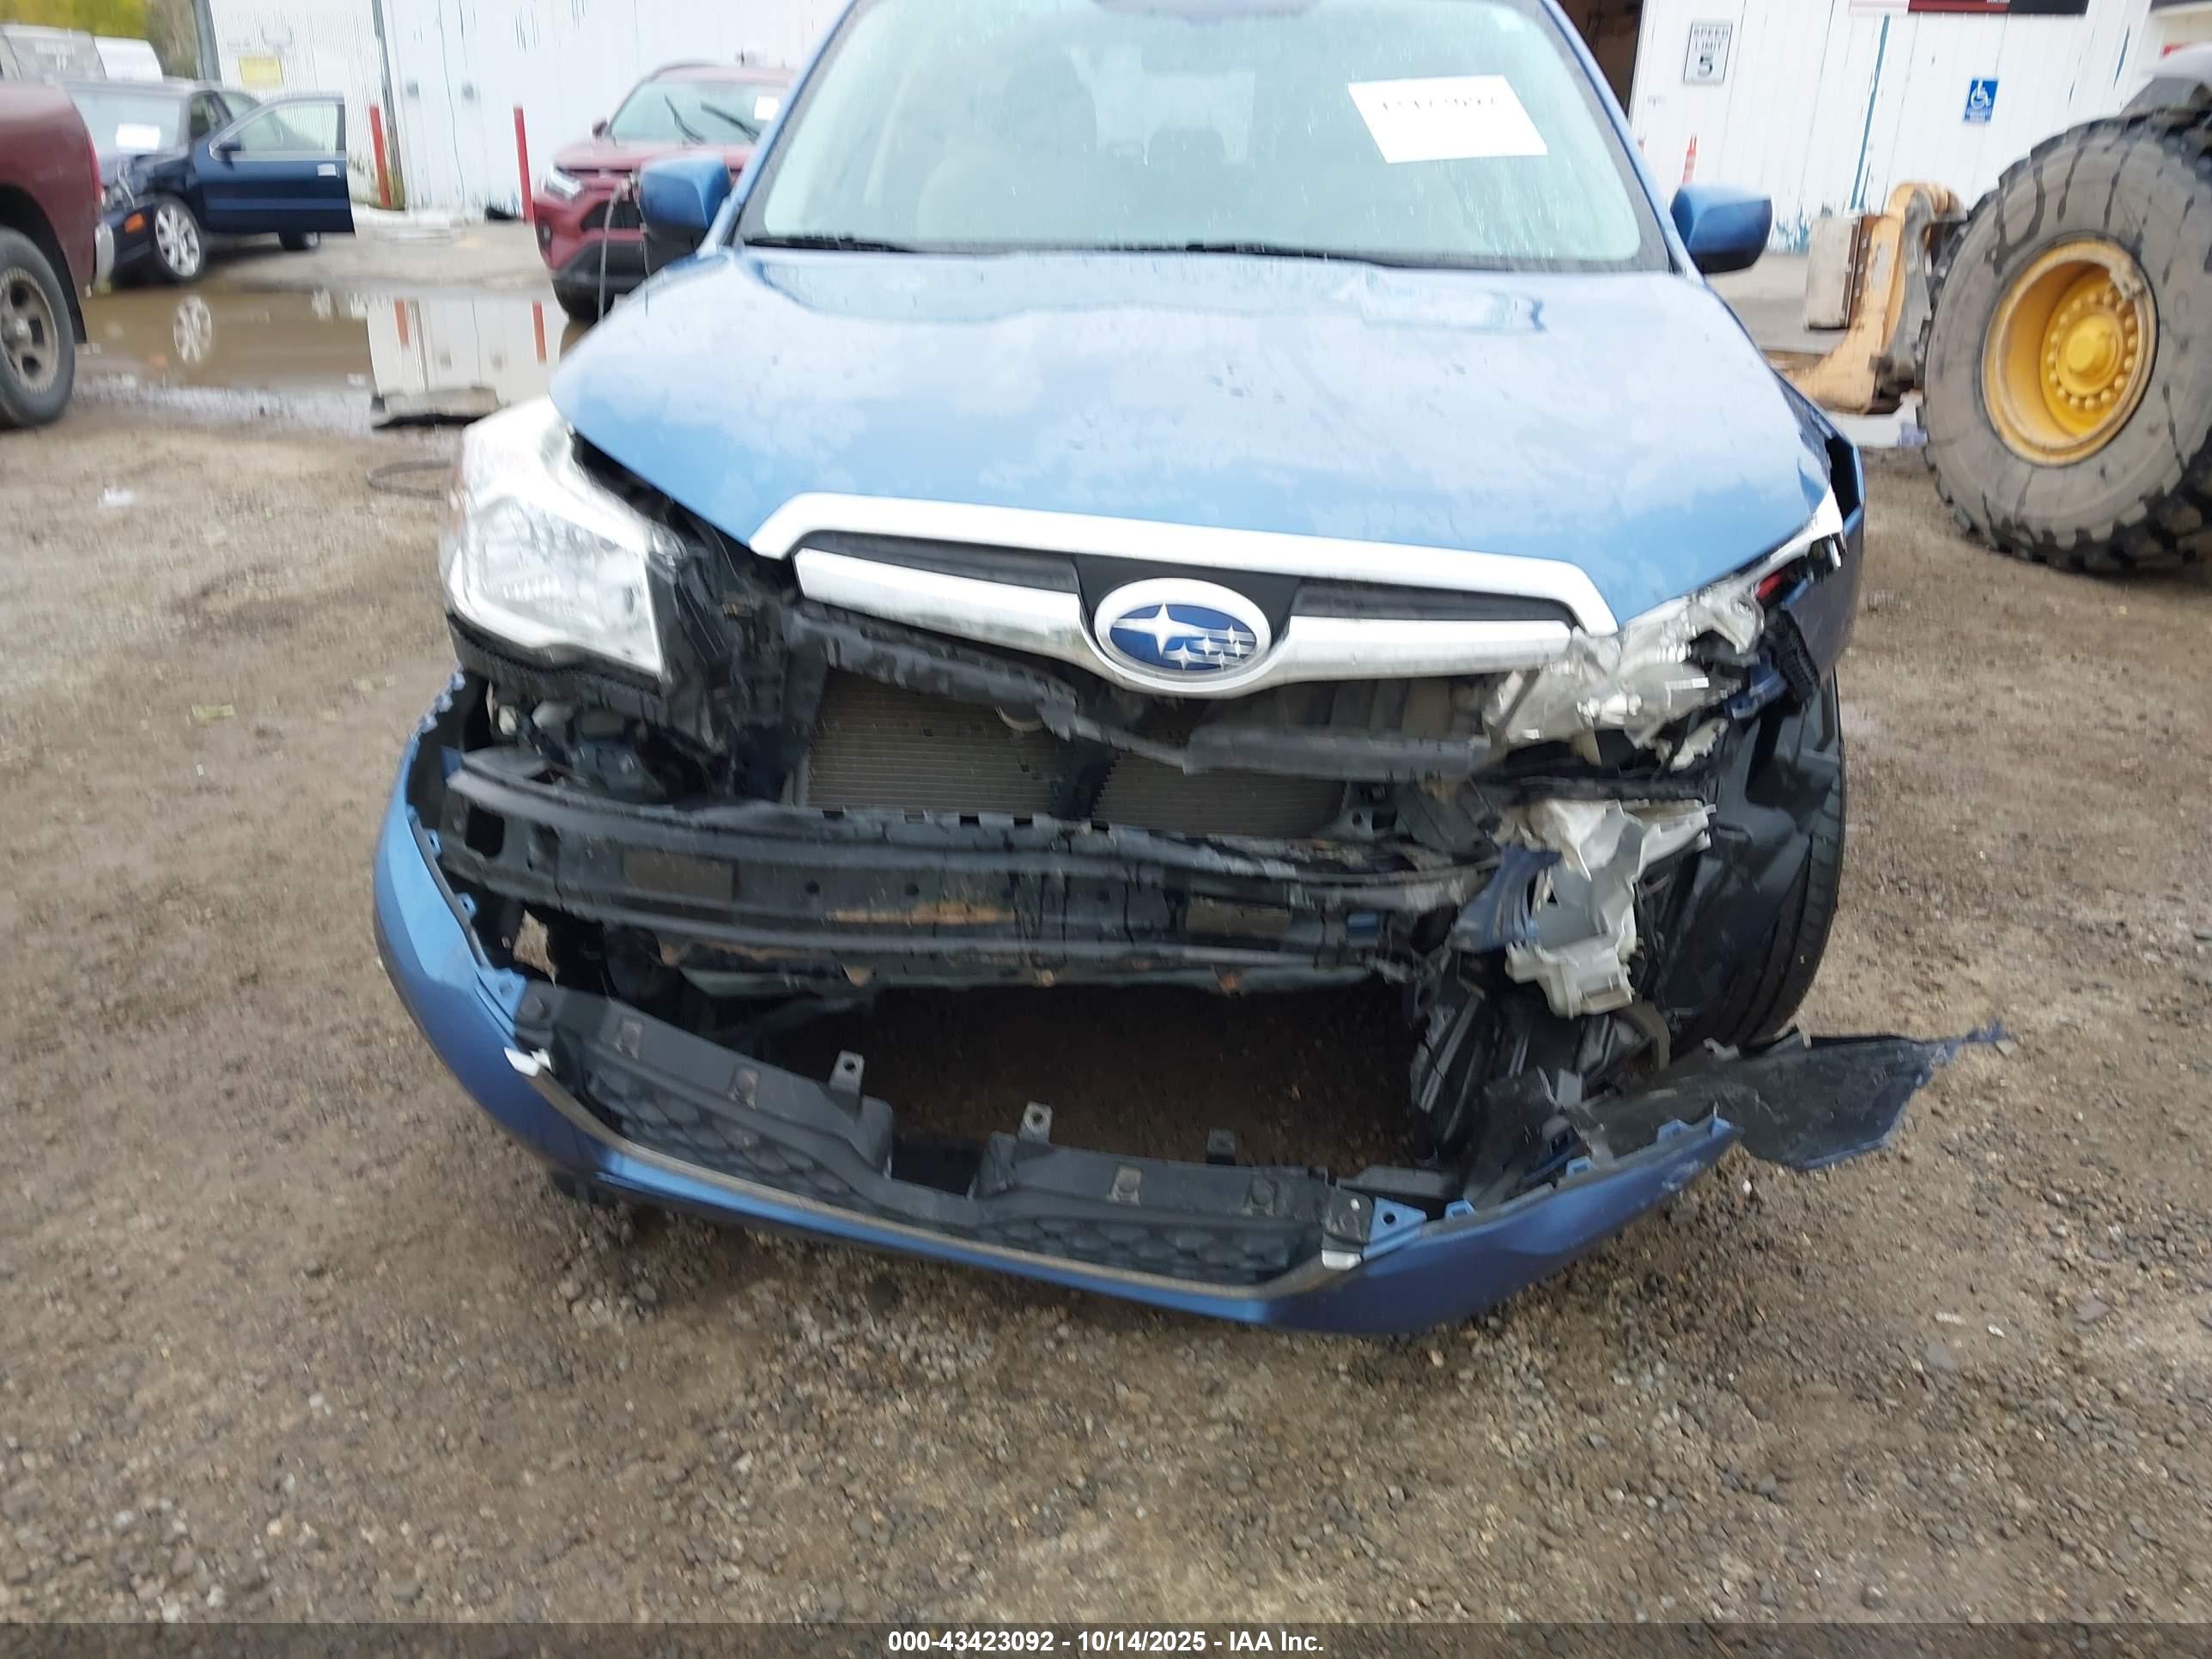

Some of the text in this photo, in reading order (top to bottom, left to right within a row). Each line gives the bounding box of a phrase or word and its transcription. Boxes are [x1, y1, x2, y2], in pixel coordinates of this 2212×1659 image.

[1693, 27, 1729, 39] SPEED
[1694, 39, 1722, 52] LIMIT
[1698, 53, 1714, 77] 5
